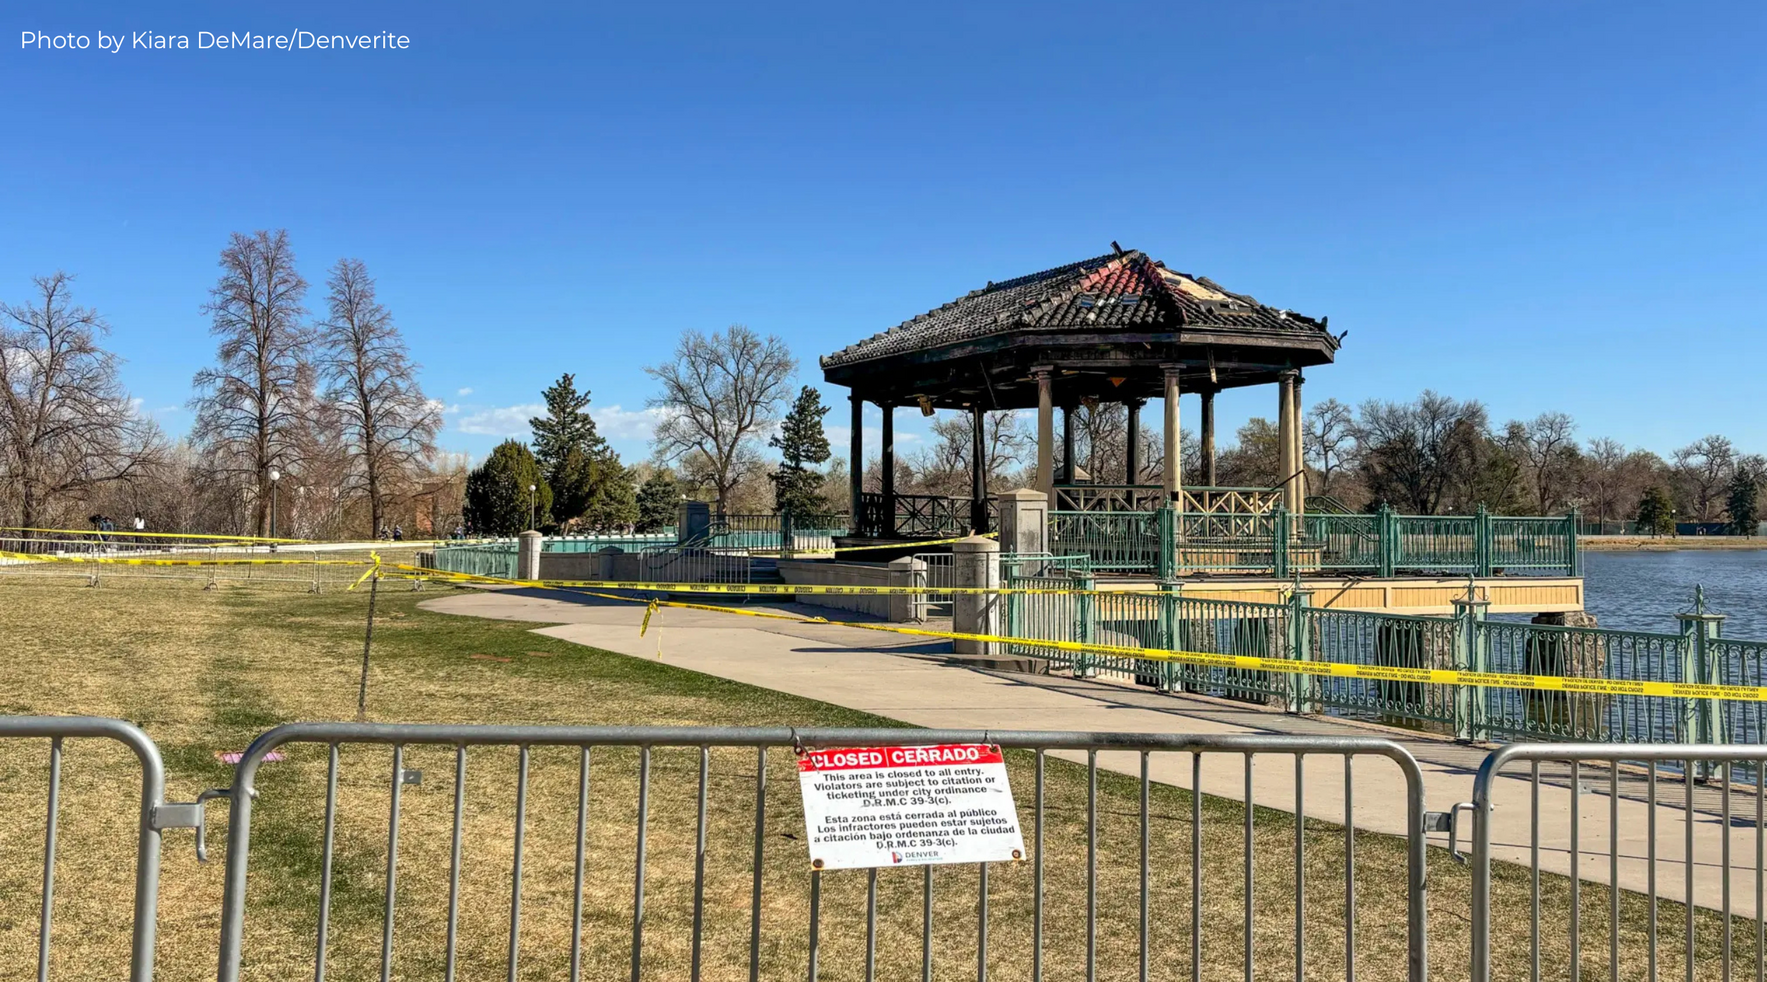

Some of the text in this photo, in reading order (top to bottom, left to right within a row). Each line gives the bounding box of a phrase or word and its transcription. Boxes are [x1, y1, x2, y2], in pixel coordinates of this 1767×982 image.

[811, 748, 979, 767] CLOSED CERRADO
[823, 773, 845, 781] This
[876, 771, 884, 779] is
[888, 770, 922, 778] closed
[925, 769, 935, 777] to
[939, 768, 951, 776] all
[955, 768, 984, 776] entry.
[814, 783, 862, 791] Violators
[886, 779, 925, 788] subject
[928, 778, 939, 786] to
[942, 776, 982, 785] citation
[827, 786, 987, 800] ticketing under city ordinance
[863, 796, 951, 807] D.R.M.C 39-3(c).
[825, 815, 848, 824] Esta
[879, 812, 902, 821] está
[905, 811, 944, 819] cerrada
[948, 810, 957, 818] al
[960, 808, 997, 818] público
[818, 817, 1007, 833] Los infractores pueden estar sujetos
[824, 832, 866, 842] citación
[870, 831, 892, 841] bajo
[896, 829, 949, 839] ordenanza
[953, 828, 965, 836] de
[968, 827, 977, 835] la
[981, 825, 1015, 834] ciudad
[877, 838, 957, 849] D.R.M.C 39-3(c).
